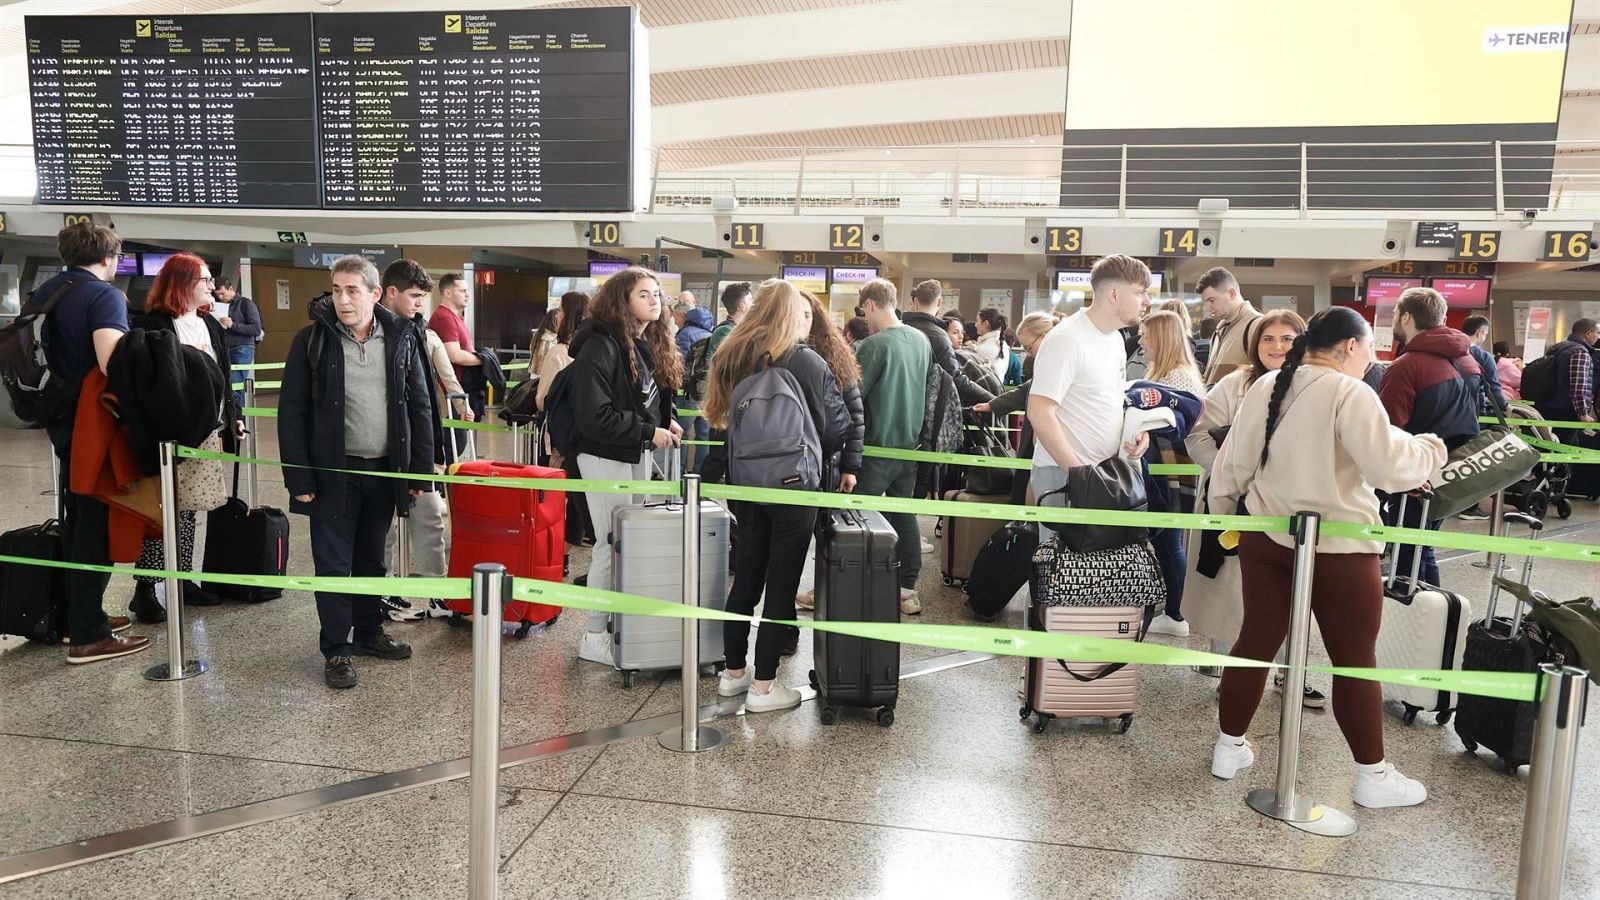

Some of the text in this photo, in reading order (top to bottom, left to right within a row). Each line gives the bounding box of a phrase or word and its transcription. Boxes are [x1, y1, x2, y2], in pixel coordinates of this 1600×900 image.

[593, 224, 618, 244] 10
[735, 225, 759, 245] 11
[833, 226, 861, 247] 12
[1049, 229, 1080, 251] 13
[1163, 230, 1195, 252] 14
[1460, 233, 1496, 257] 15
[1549, 233, 1588, 257] 16
[1442, 442, 1519, 482] adidas
[1072, 568, 1085, 576] PLT
[1086, 568, 1099, 576] PLT
[1100, 568, 1111, 577] PLT
[1092, 561, 1104, 569] PLT
[1120, 570, 1145, 579] PLT PLT
[1065, 576, 1078, 584] PLT
[1079, 576, 1092, 585] PLT
[1093, 587, 1105, 595] PLT
[1130, 585, 1144, 593] PLT
[1144, 586, 1156, 594] PLT
[1113, 578, 1125, 586] PLT
[1126, 578, 1139, 586] PLT
